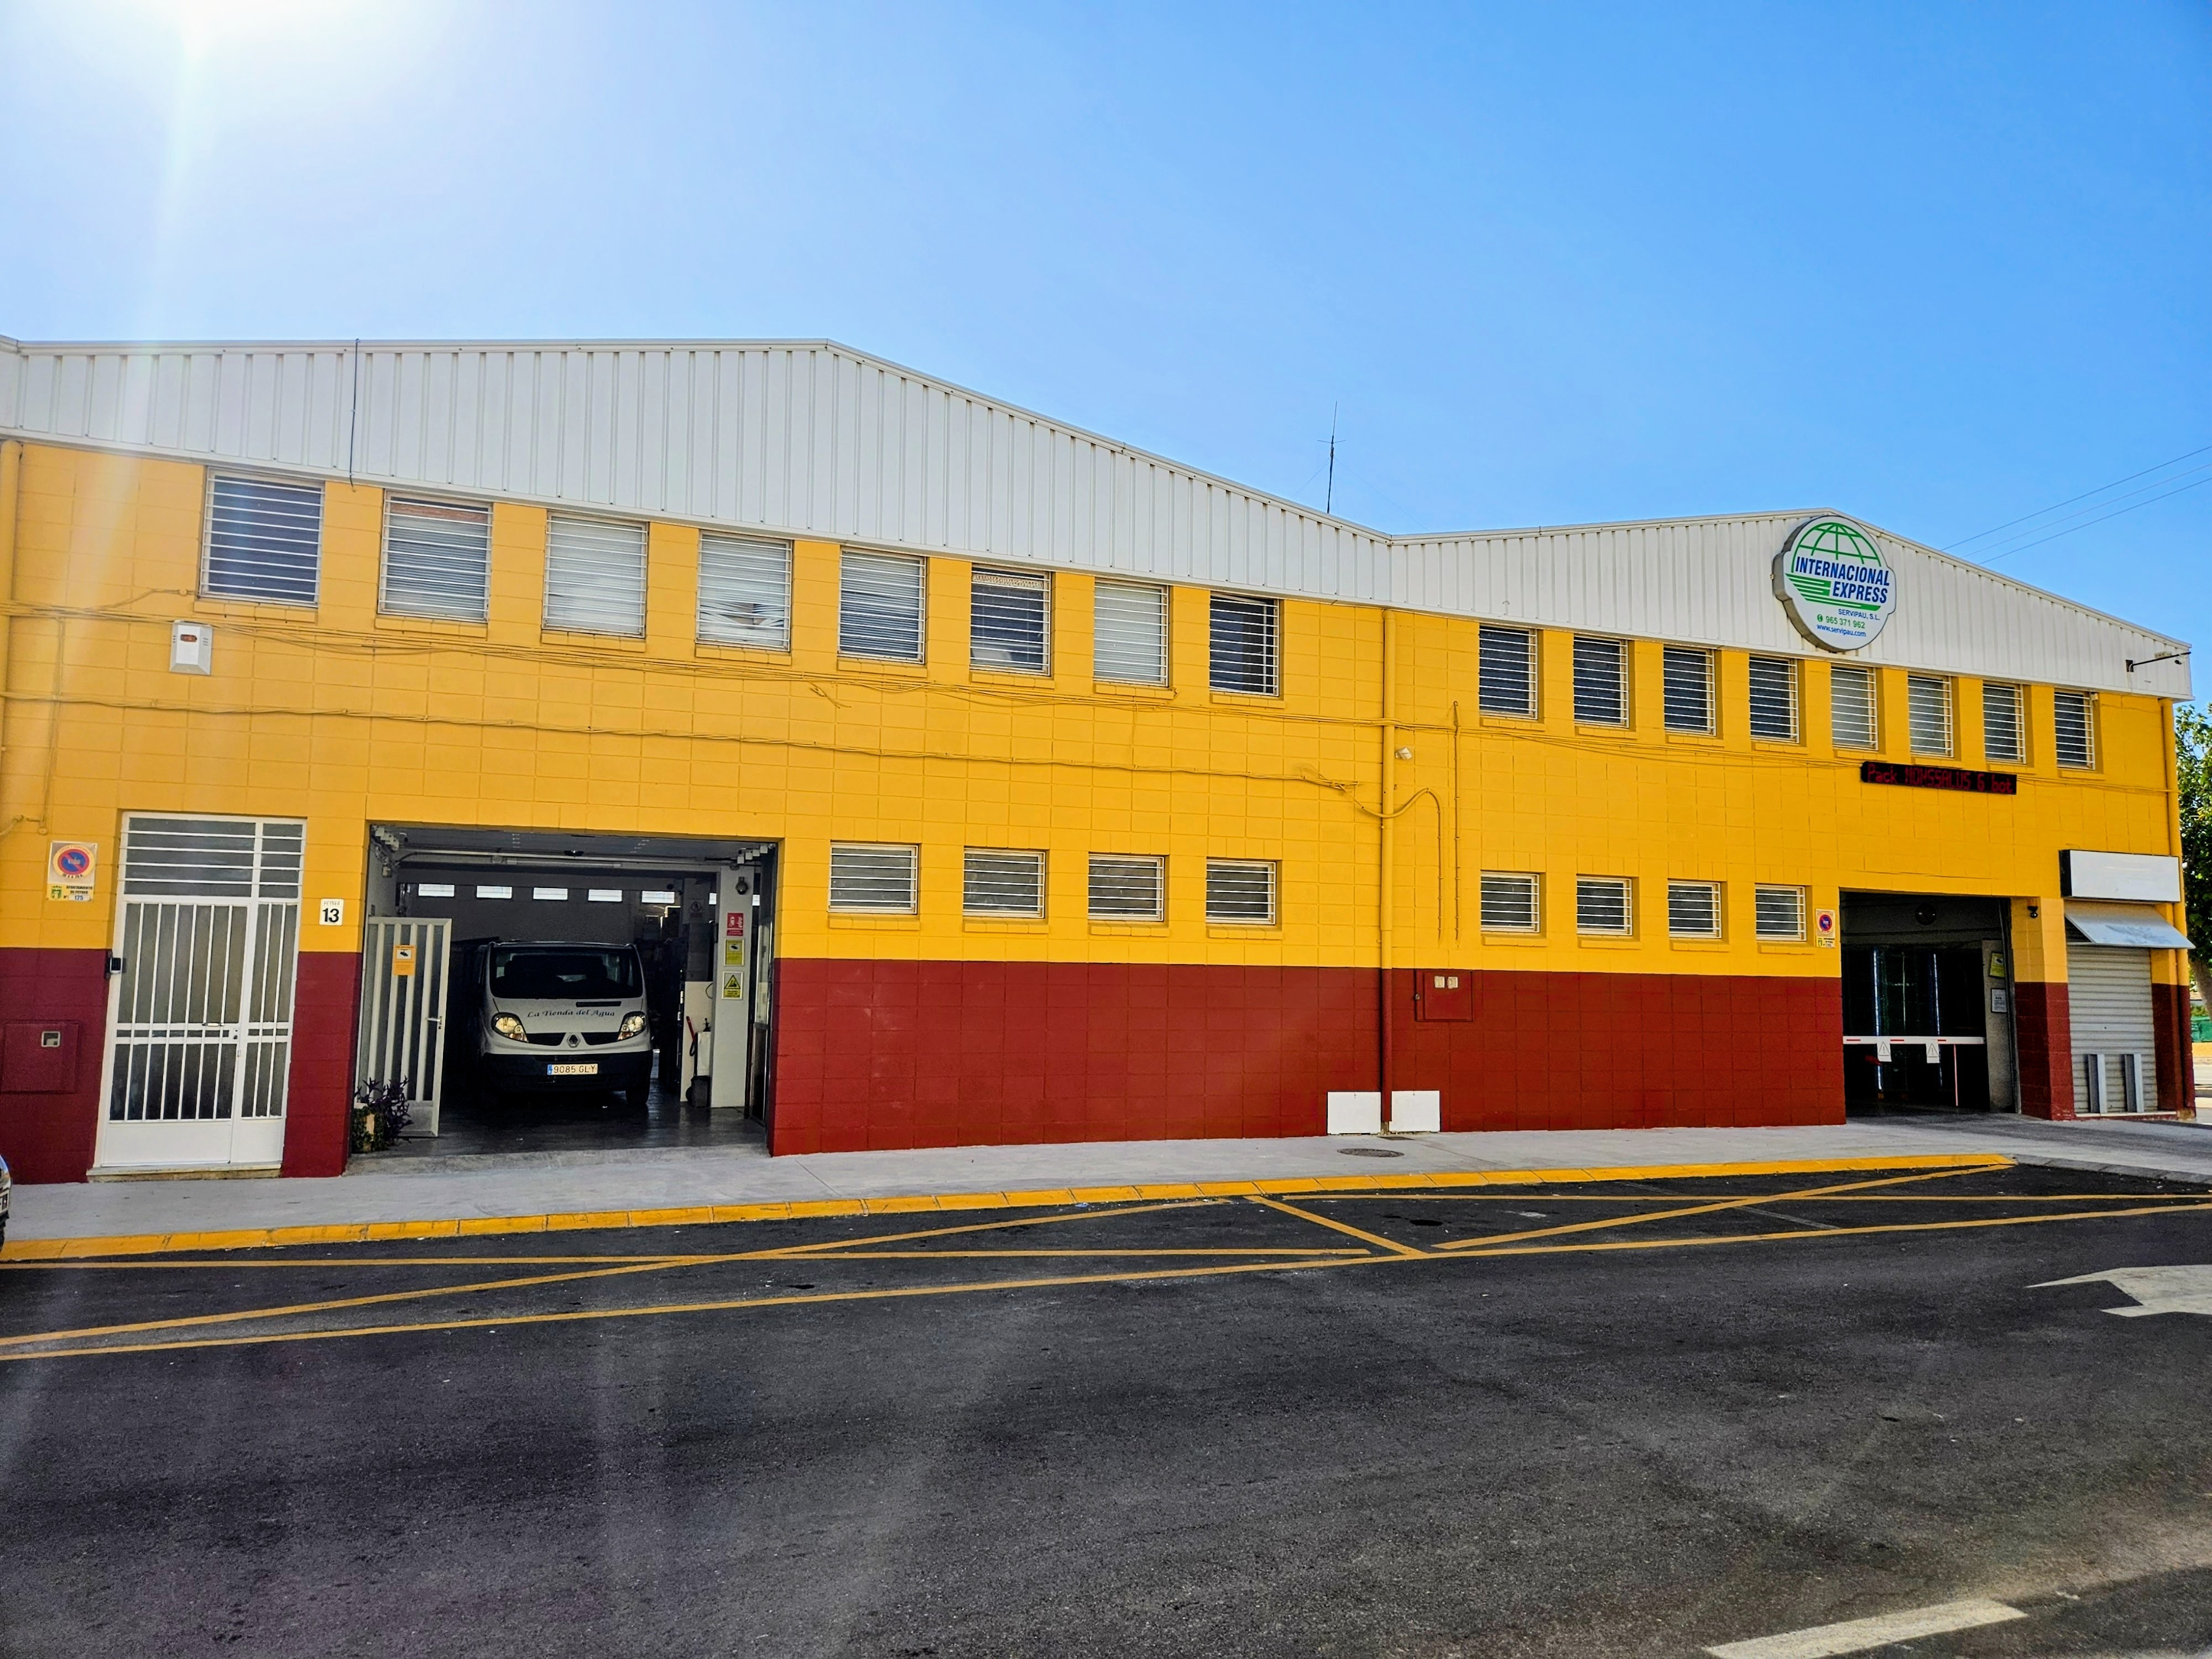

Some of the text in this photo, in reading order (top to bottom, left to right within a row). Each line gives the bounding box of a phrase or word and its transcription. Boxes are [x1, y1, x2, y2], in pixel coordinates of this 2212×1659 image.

[1795, 556, 1890, 587] INTERNACIONAL
[1832, 581, 1888, 604] EXPRESS
[1838, 608, 1869, 619] SERVIPAU,
[1825, 615, 1866, 629] 965 371 962
[1817, 624, 1866, 637] www.servipau.com
[1867, 763, 1898, 784] Pack
[1977, 774, 1985, 792] 6
[322, 907, 340, 923] 13
[579, 1065, 596, 1073] GLY
